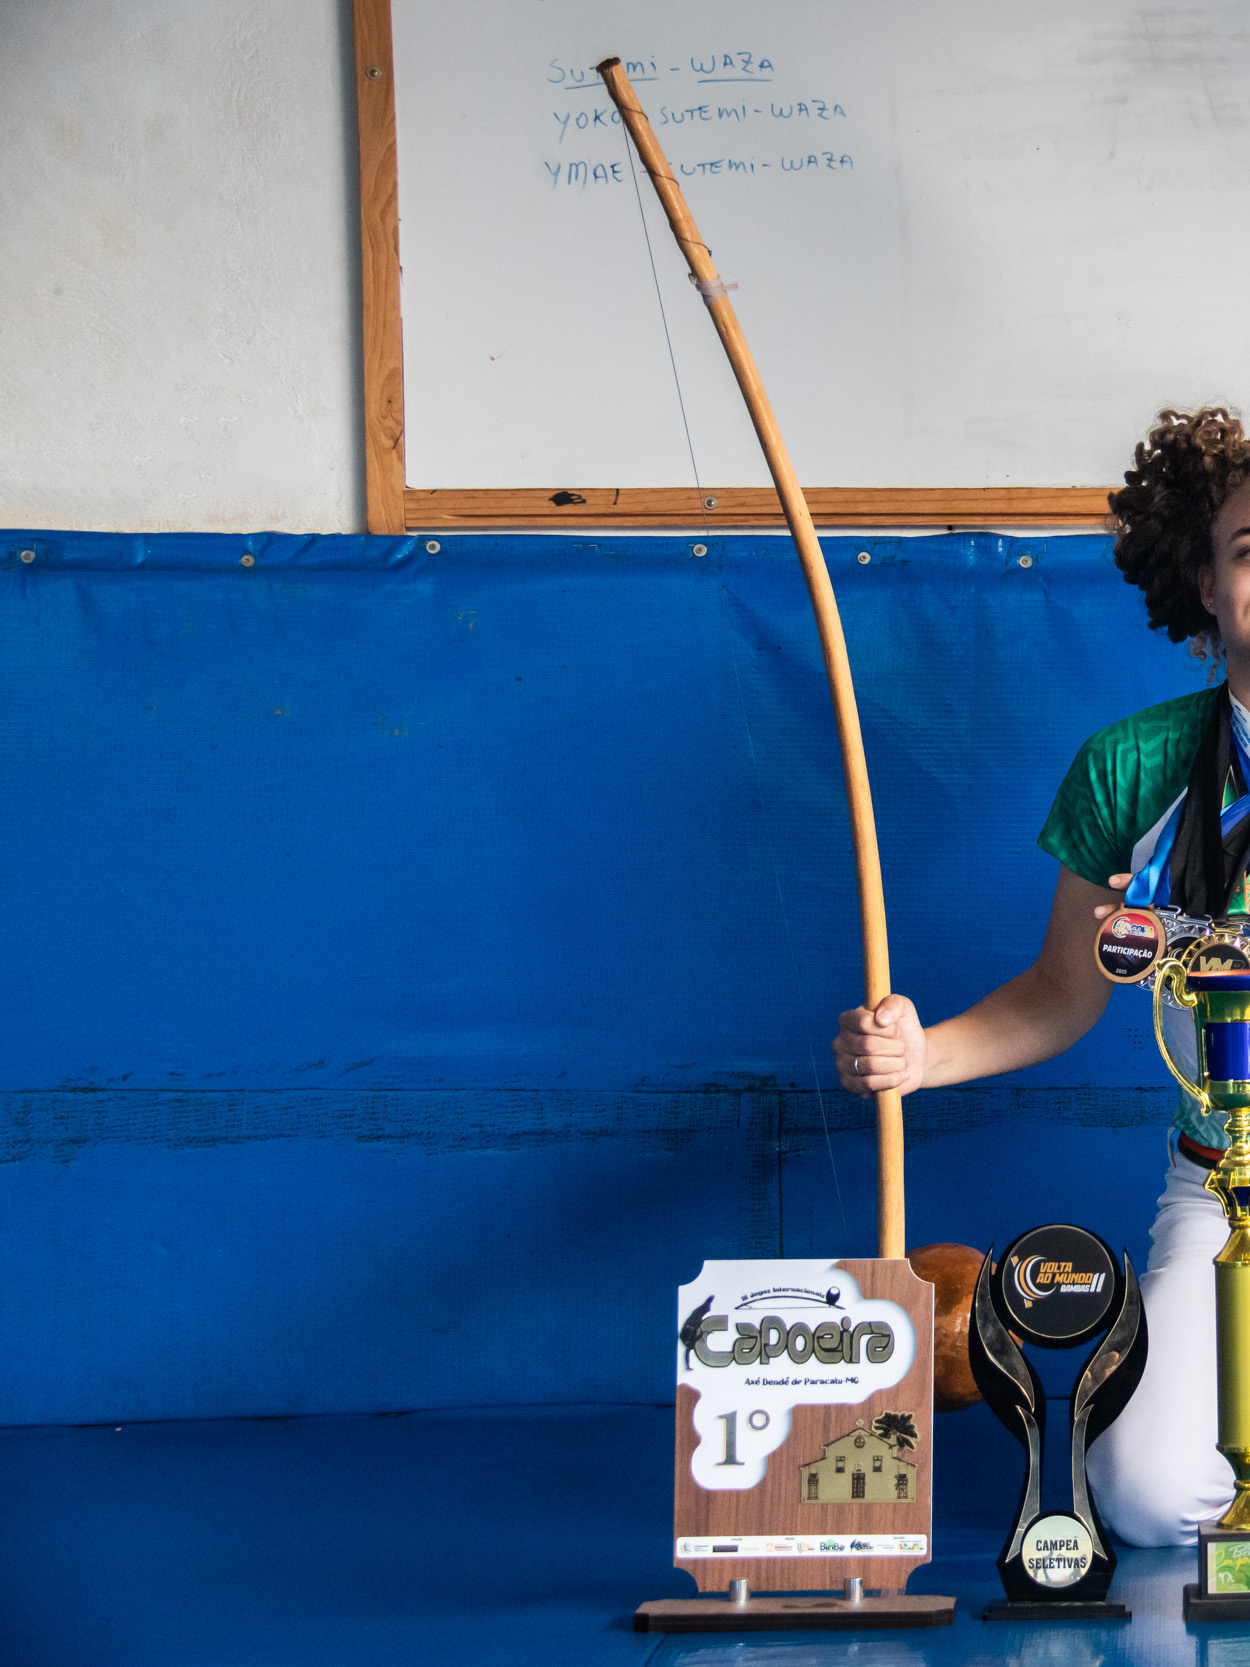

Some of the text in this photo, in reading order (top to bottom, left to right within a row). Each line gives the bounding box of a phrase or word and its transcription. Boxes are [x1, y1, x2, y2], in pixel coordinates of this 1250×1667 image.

[544, 161, 625, 190] YMAE
[1102, 943, 1153, 959] PARTICIPAÇÃO
[1039, 1262, 1073, 1273] VOLTA
[1036, 1273, 1094, 1284] AO MUNDO
[750, 1288, 771, 1299] Jogos
[773, 1287, 826, 1299] Internacionais
[1060, 1284, 1091, 1293] BAMBAS
[694, 1315, 895, 1368] Capoeira
[744, 1376, 761, 1386] Axé
[1035, 1536, 1080, 1552] CAMPEÃ
[1028, 1556, 1088, 1570] SELETIVAS
